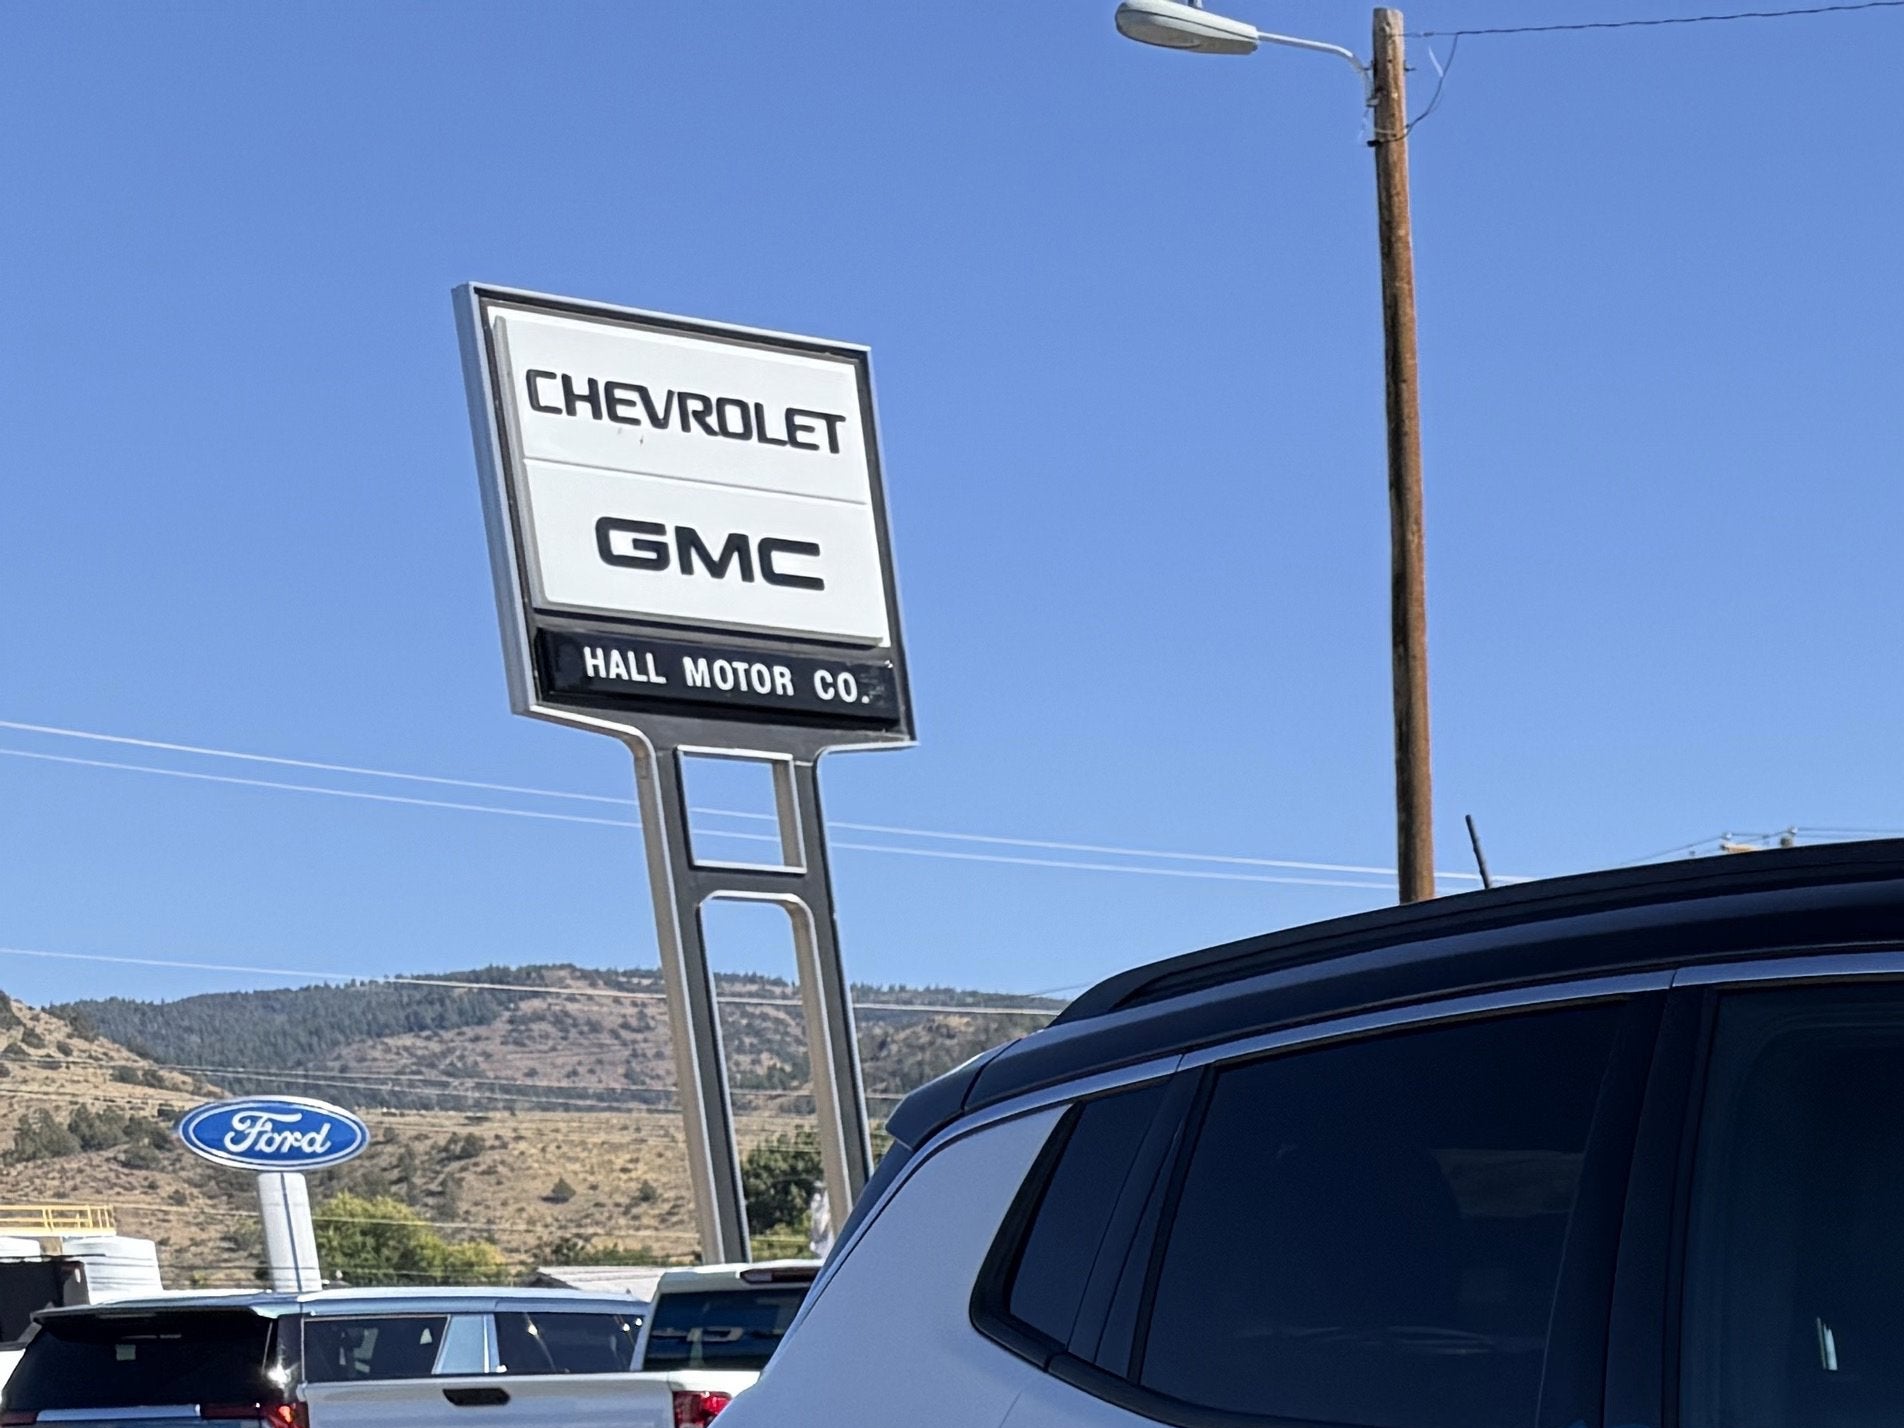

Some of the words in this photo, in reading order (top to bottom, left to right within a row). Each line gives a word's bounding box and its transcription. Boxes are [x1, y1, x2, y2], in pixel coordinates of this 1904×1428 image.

[525, 368, 846, 454] CHEVROLET
[595, 515, 826, 591] GMC
[583, 645, 667, 686] HALL
[682, 655, 795, 697] MOTOR
[813, 668, 871, 704] CO.
[223, 1110, 332, 1154] Ford
